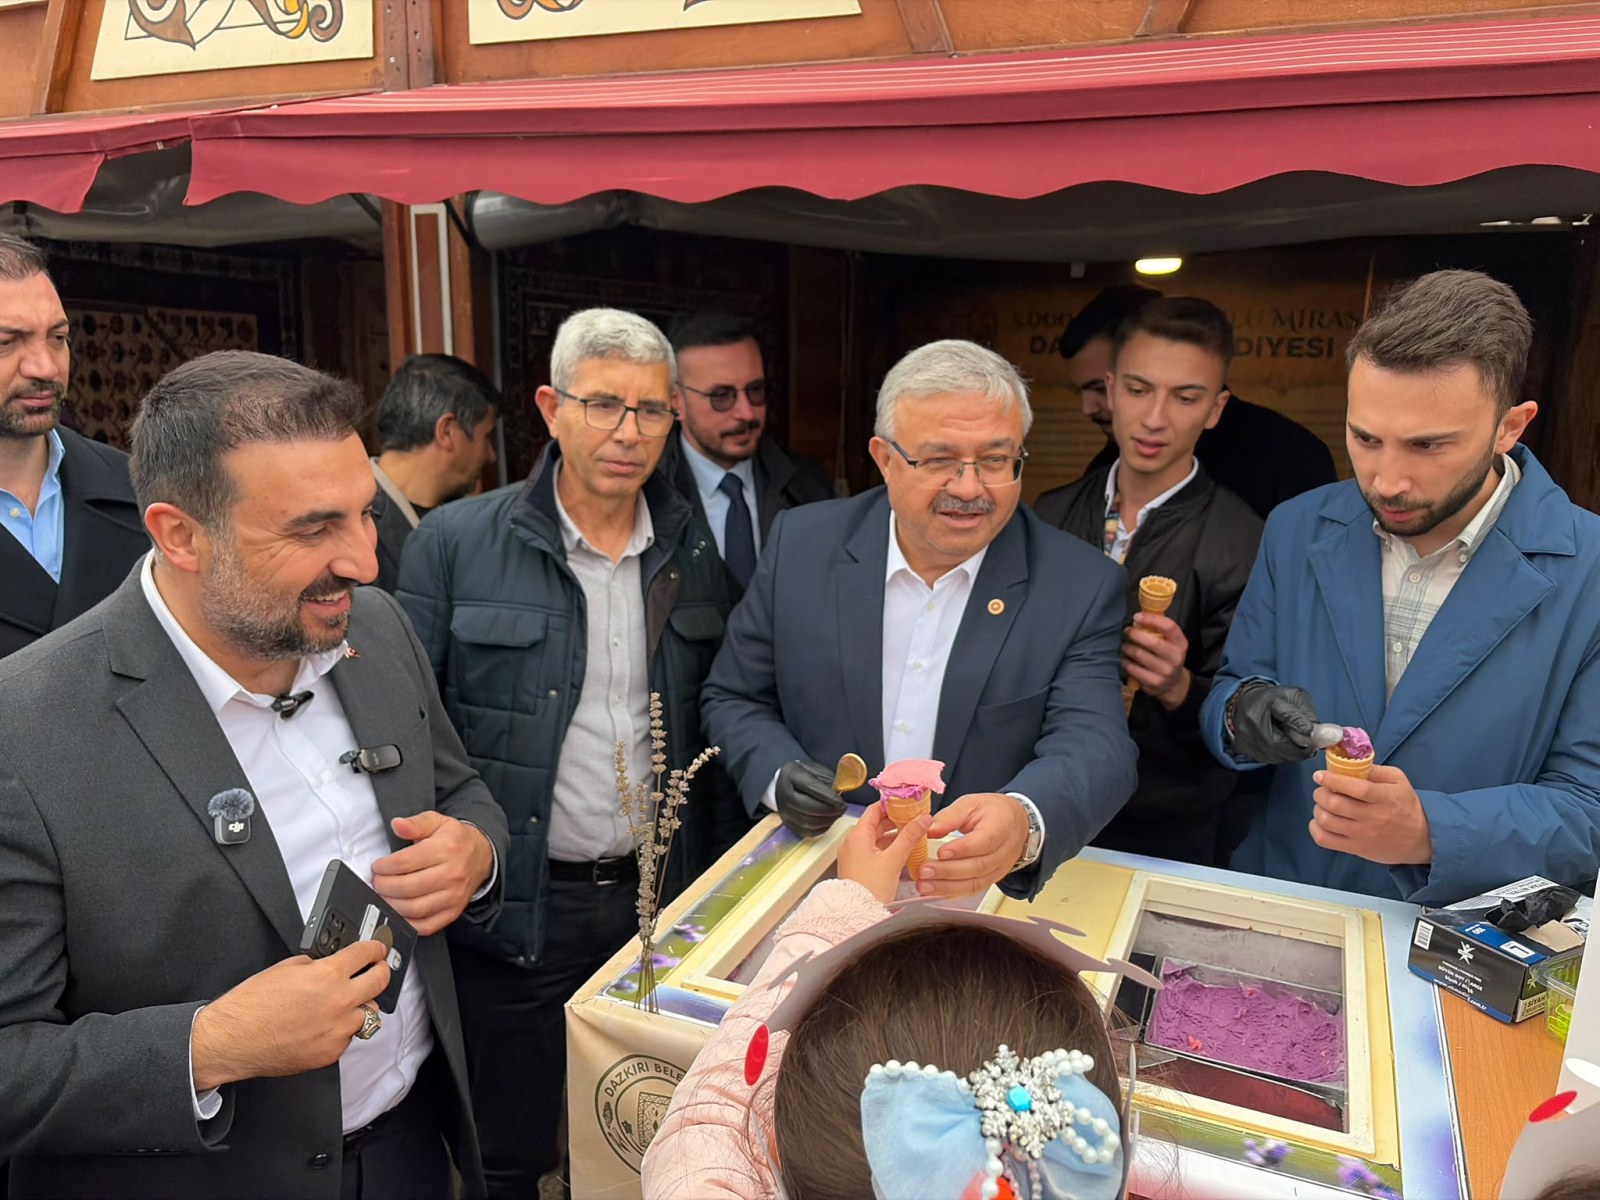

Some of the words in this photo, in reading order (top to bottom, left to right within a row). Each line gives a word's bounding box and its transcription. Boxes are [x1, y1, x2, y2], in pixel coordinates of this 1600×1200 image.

[1030, 335, 1061, 354] DA
[604, 1061, 650, 1098] DAZKIRI
[654, 1063, 684, 1082] BELE
